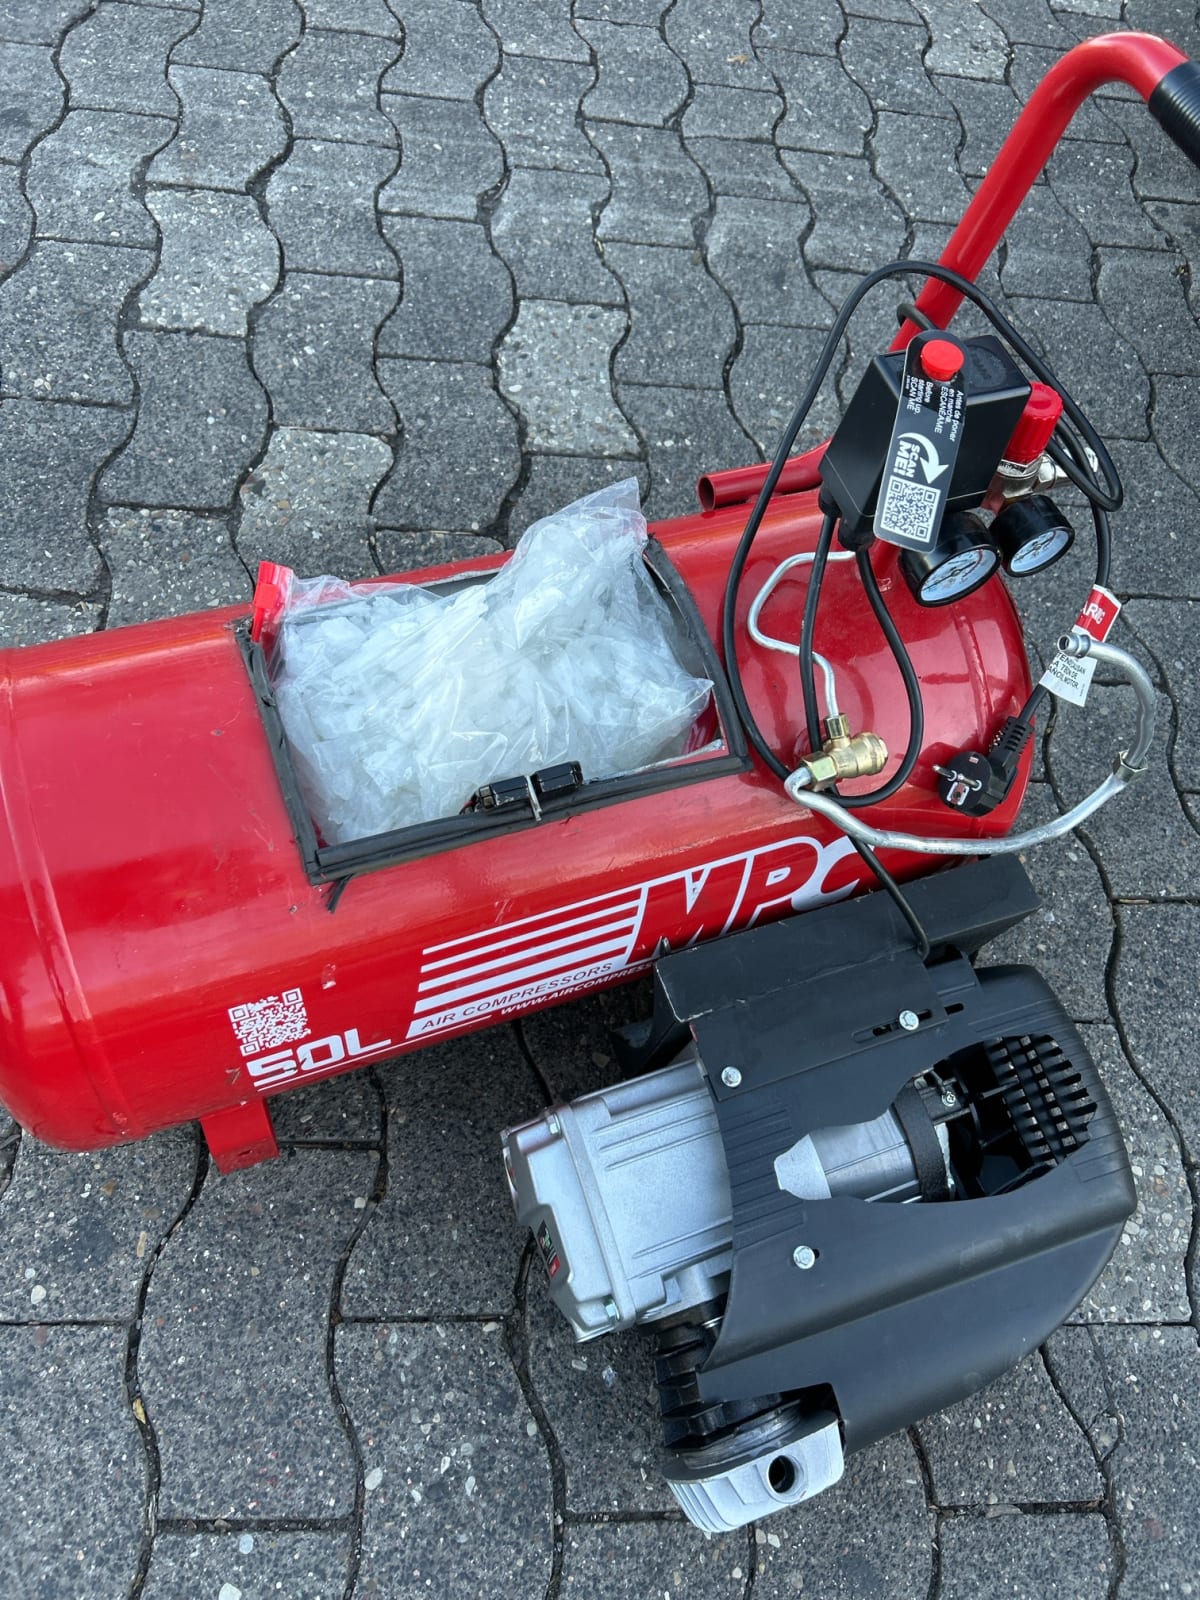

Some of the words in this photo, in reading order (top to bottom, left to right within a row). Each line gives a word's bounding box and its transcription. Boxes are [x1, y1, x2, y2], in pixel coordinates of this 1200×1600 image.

[909, 376, 919, 398] SCAN
[924, 381, 934, 403] Before
[948, 388, 955, 398] en
[906, 398, 915, 411] ME
[955, 390, 964, 409] Antes
[953, 410, 961, 419] de
[949, 419, 959, 442] poner
[893, 440, 912, 476] ME!
[905, 443, 921, 478] SCAN
[625, 835, 875, 967] MPC
[422, 1011, 456, 1031] AIR
[462, 962, 613, 1016] COMPRESSORS
